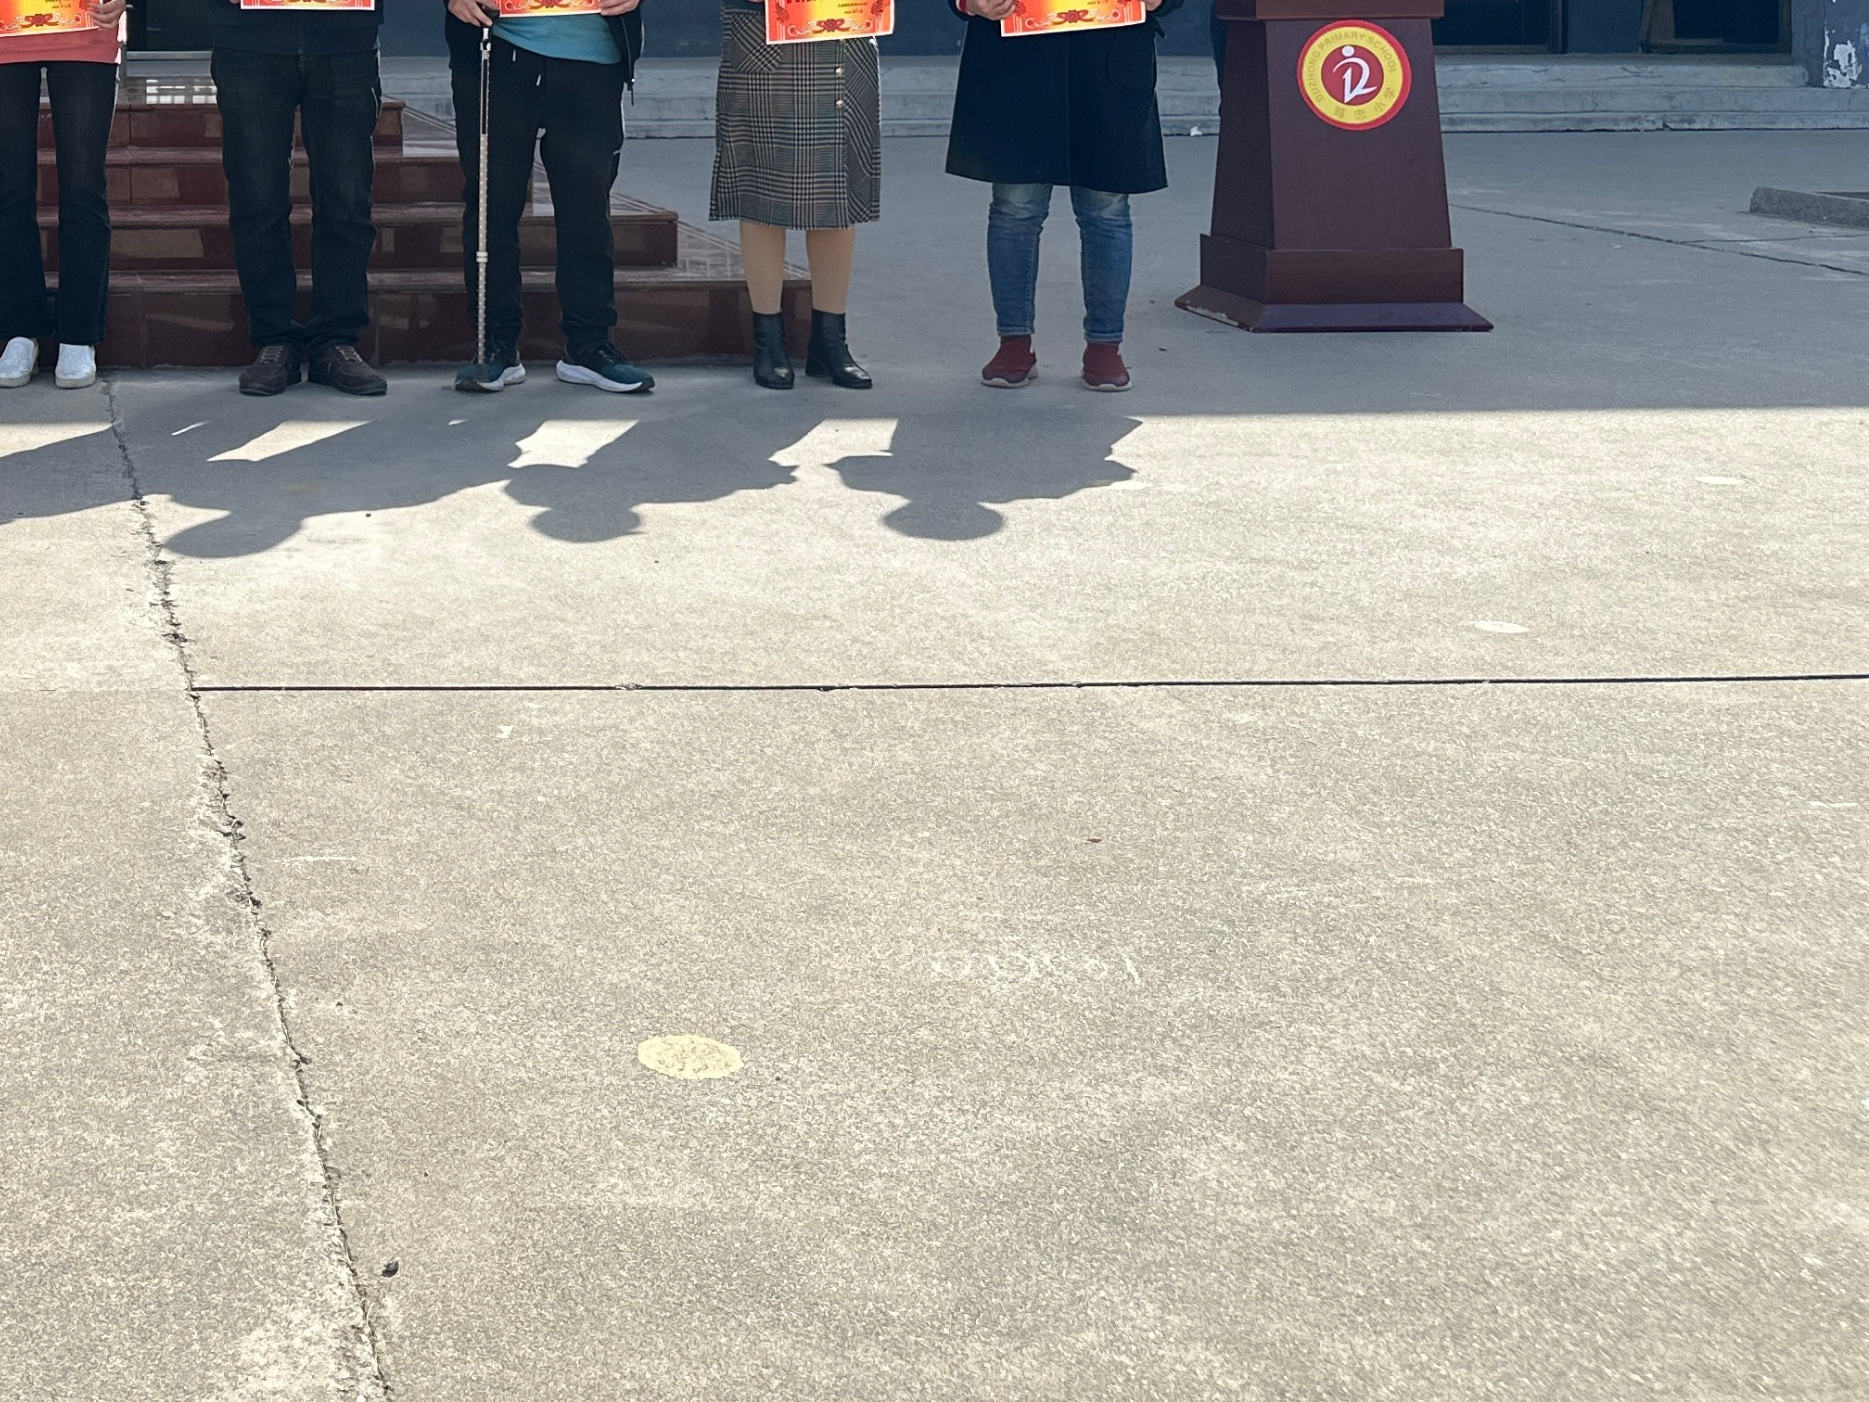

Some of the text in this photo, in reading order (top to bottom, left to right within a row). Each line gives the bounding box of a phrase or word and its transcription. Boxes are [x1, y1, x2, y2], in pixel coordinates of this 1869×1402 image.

[1307, 31, 1397, 103] DUZHONG PRIMARY SCHOOL
